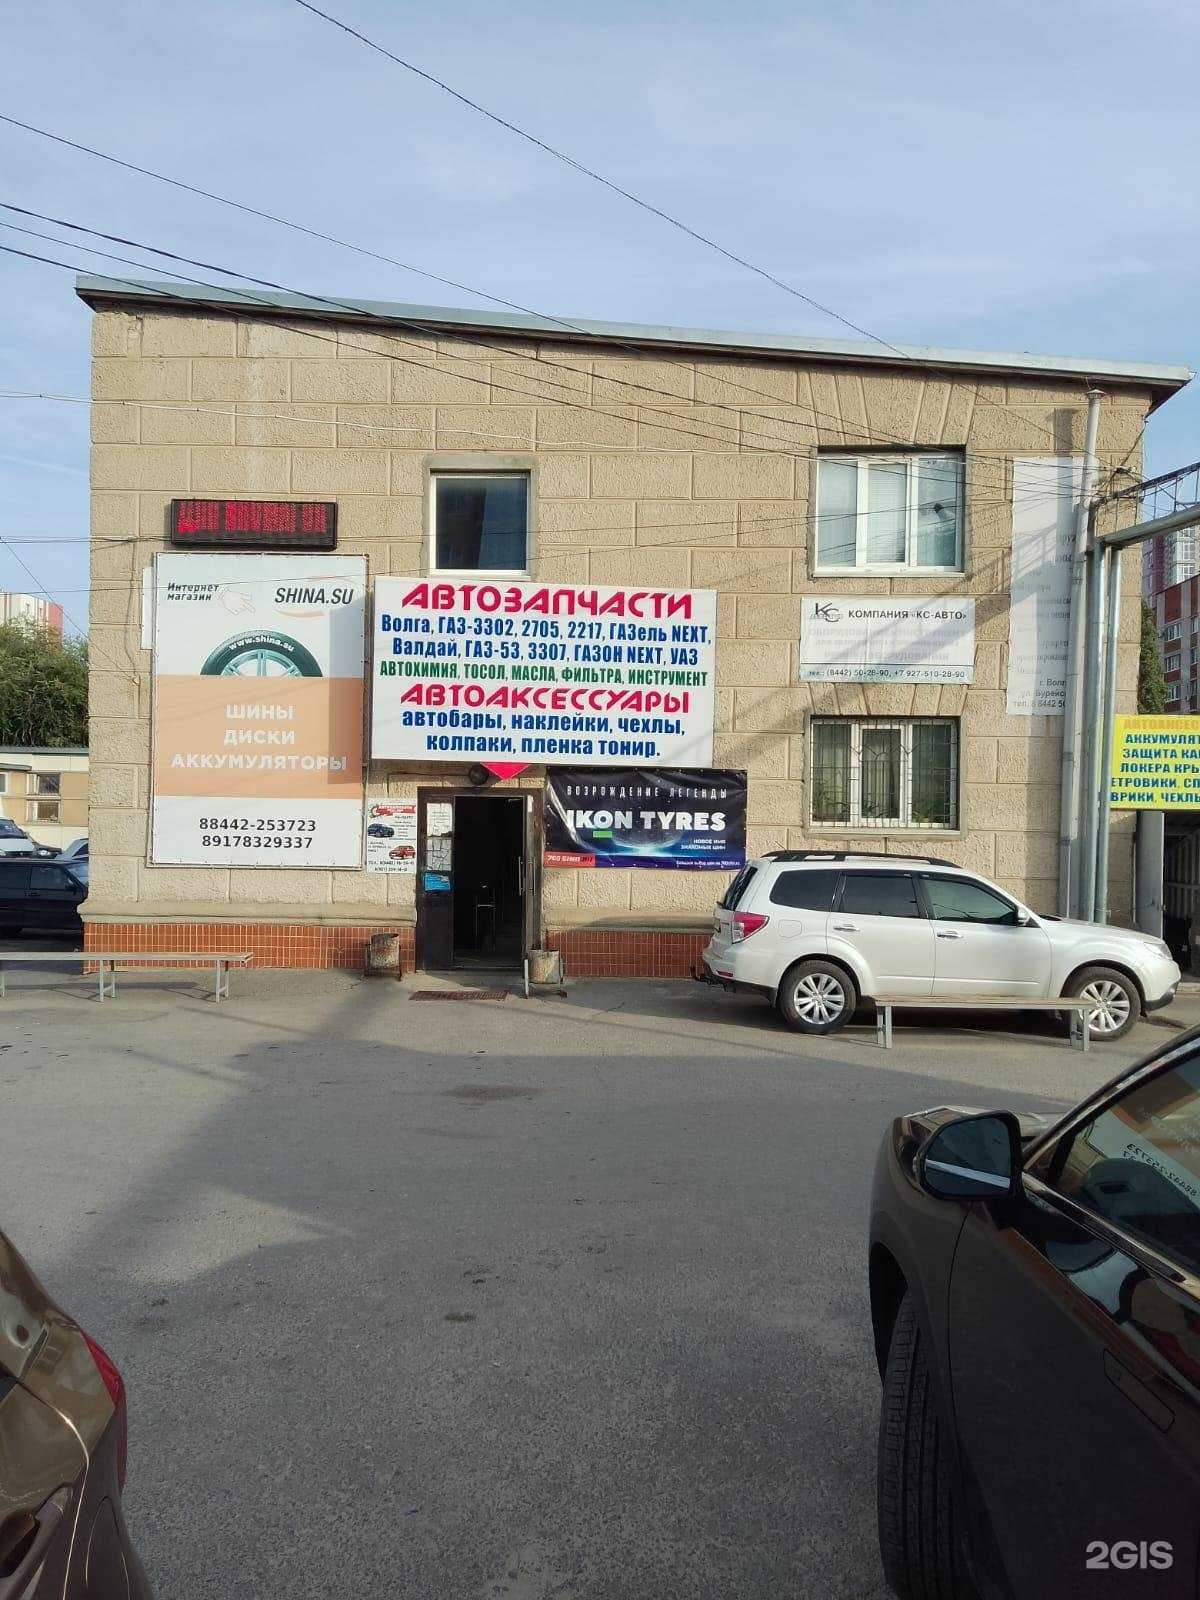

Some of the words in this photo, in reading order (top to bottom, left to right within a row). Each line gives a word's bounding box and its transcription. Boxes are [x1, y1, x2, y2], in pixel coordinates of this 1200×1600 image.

[167, 582, 220, 593] Интернет
[167, 592, 213, 601] магазин
[275, 587, 354, 605] SHINA.SU
[401, 583, 692, 619] АВТОЗАПЧАСТИ
[848, 609, 909, 620] КОМПАНИЯ
[381, 614, 434, 635] Волга,
[438, 616, 518, 637] ГАЗ-3302,
[521, 619, 563, 640] 2705,
[567, 621, 606, 641] 2217,
[609, 622, 668, 642] ГАЗель
[671, 625, 712, 645] NEXT,
[229, 634, 295, 652] www.shina.su
[392, 637, 461, 659] Валдай,
[465, 640, 524, 661] ГАЗ-53,
[528, 642, 570, 662] 3307,
[574, 644, 623, 663] ГАЗОН
[627, 646, 667, 666] NEXT,
[670, 648, 698, 666] УАЗ
[380, 660, 461, 679] АВТОХИМИЯ,
[464, 663, 509, 681] ТОСОЛ,
[511, 665, 559, 683] МАСЛА,
[561, 666, 625, 685] ФИЛЬТРА,
[628, 669, 708, 687] ИНСТРУМЕНТ
[400, 683, 690, 714] АВТОАКСЕССУАРЫ
[226, 704, 296, 721] ШИНЫ
[402, 709, 507, 730] автобары,
[511, 712, 613, 734] наклейки,
[617, 717, 686, 736] чехлы,
[223, 728, 296, 746] ДИСКИ
[426, 735, 517, 755] колпаки,
[521, 737, 593, 755] пленка
[598, 740, 661, 758] тонир.
[1122, 748, 1178, 760] ЗАЩИТА
[170, 752, 348, 771] АККУМУЛЯТОРЫ
[566, 785, 660, 798] ВОЗРОЖДЕНИЕ
[669, 788, 728, 799] ЛЕГЕНДЫ
[199, 817, 317, 832] 88442-253723
[566, 809, 633, 830] IKON
[640, 812, 726, 832] TYRES
[202, 835, 313, 849] 89178329337
